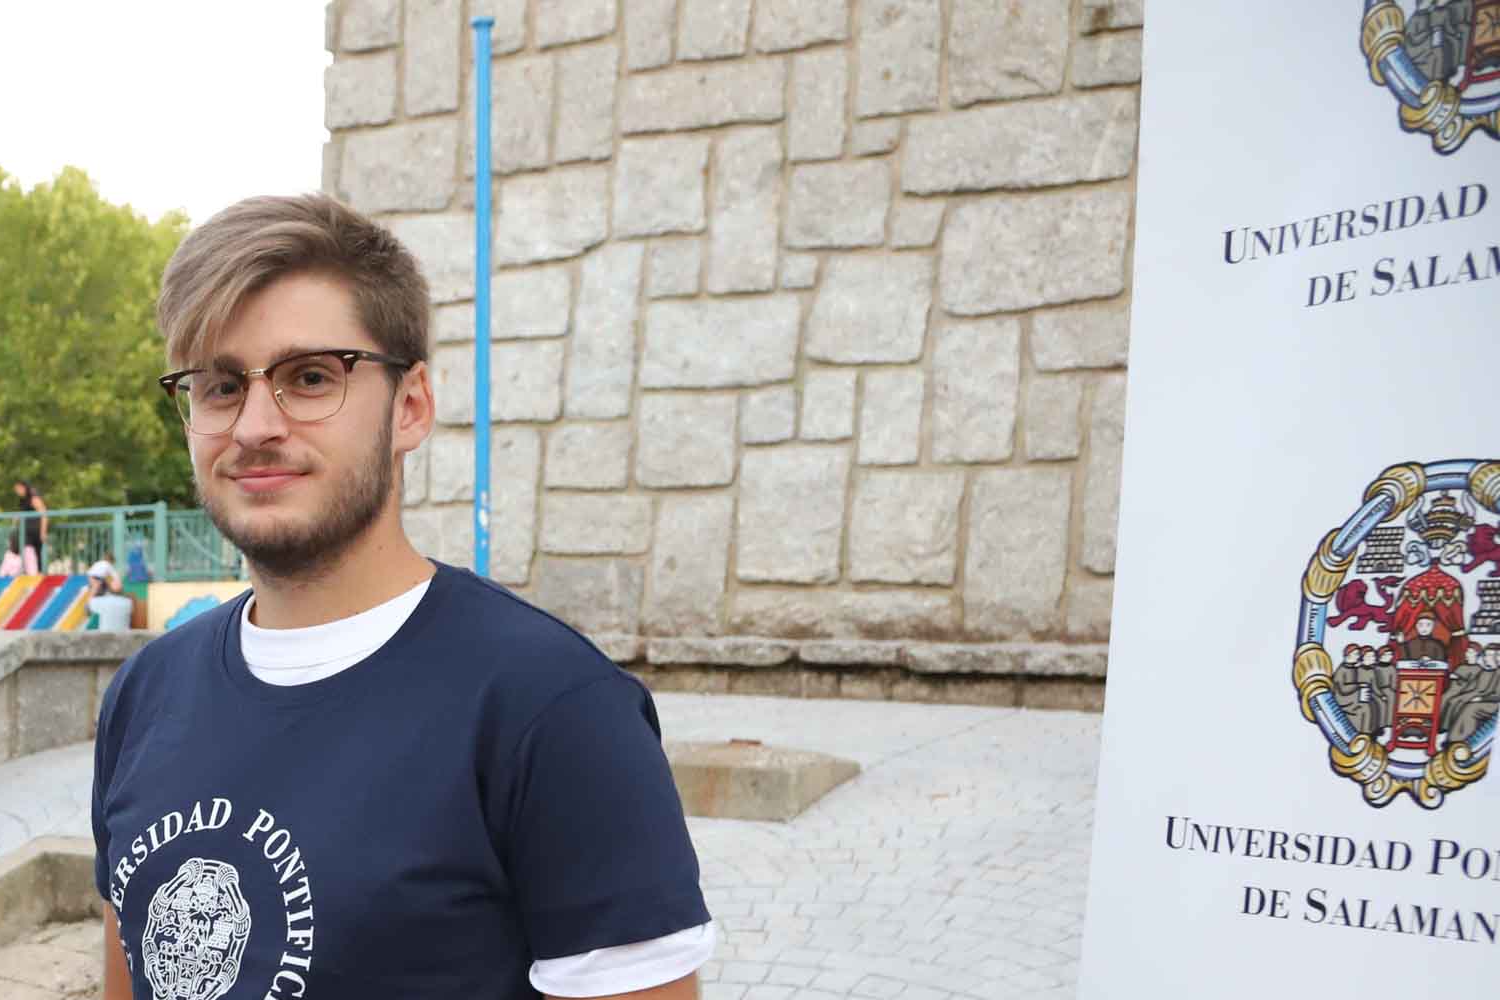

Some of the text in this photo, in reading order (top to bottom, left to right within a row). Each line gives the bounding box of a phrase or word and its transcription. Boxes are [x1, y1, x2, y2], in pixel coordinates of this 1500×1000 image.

[1222, 183, 1488, 264] UNIVERSIDAD
[1304, 271, 1358, 307] DE
[111, 798, 232, 912] ERSIDAD
[1165, 815, 1413, 872] UNIVERSIDAD
[1241, 886, 1291, 919] DE
